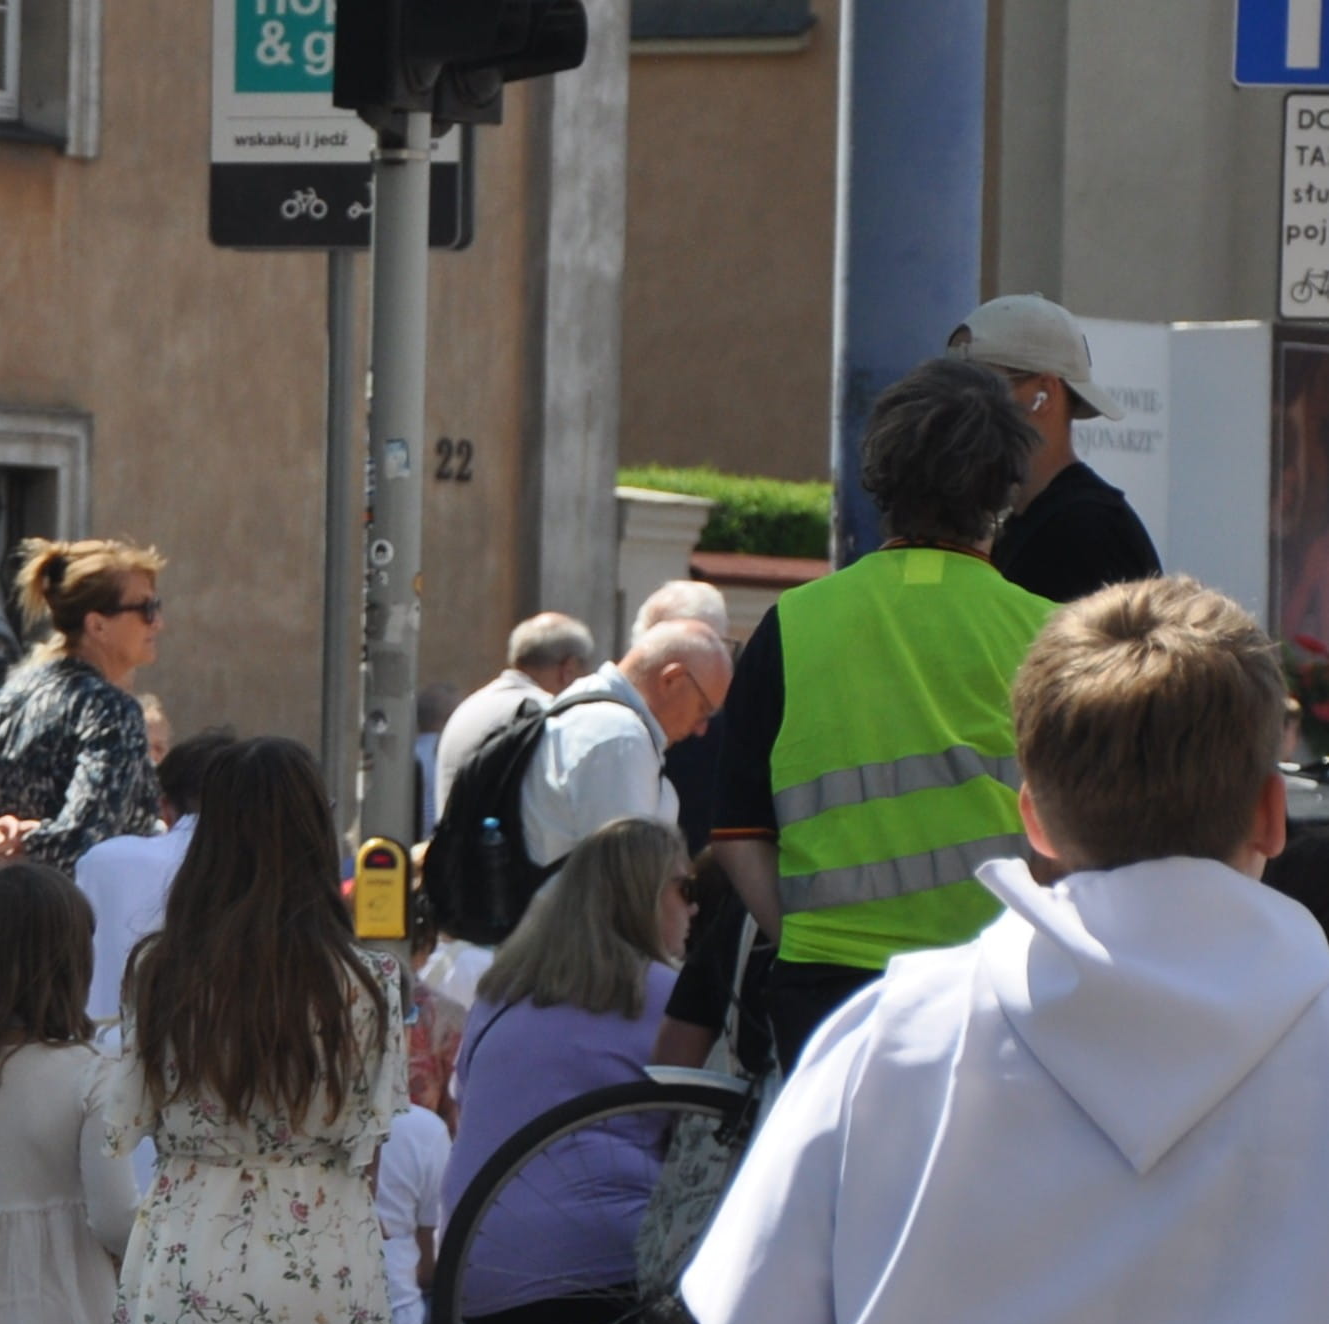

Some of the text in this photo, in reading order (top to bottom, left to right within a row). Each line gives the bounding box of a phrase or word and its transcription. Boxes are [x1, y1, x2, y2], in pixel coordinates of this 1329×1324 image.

[255, 20, 335, 76] & g
[233, 130, 301, 150] wskakuj
[304, 131, 310, 147] i
[1295, 145, 1329, 167] TA
[434, 437, 474, 482] 22
